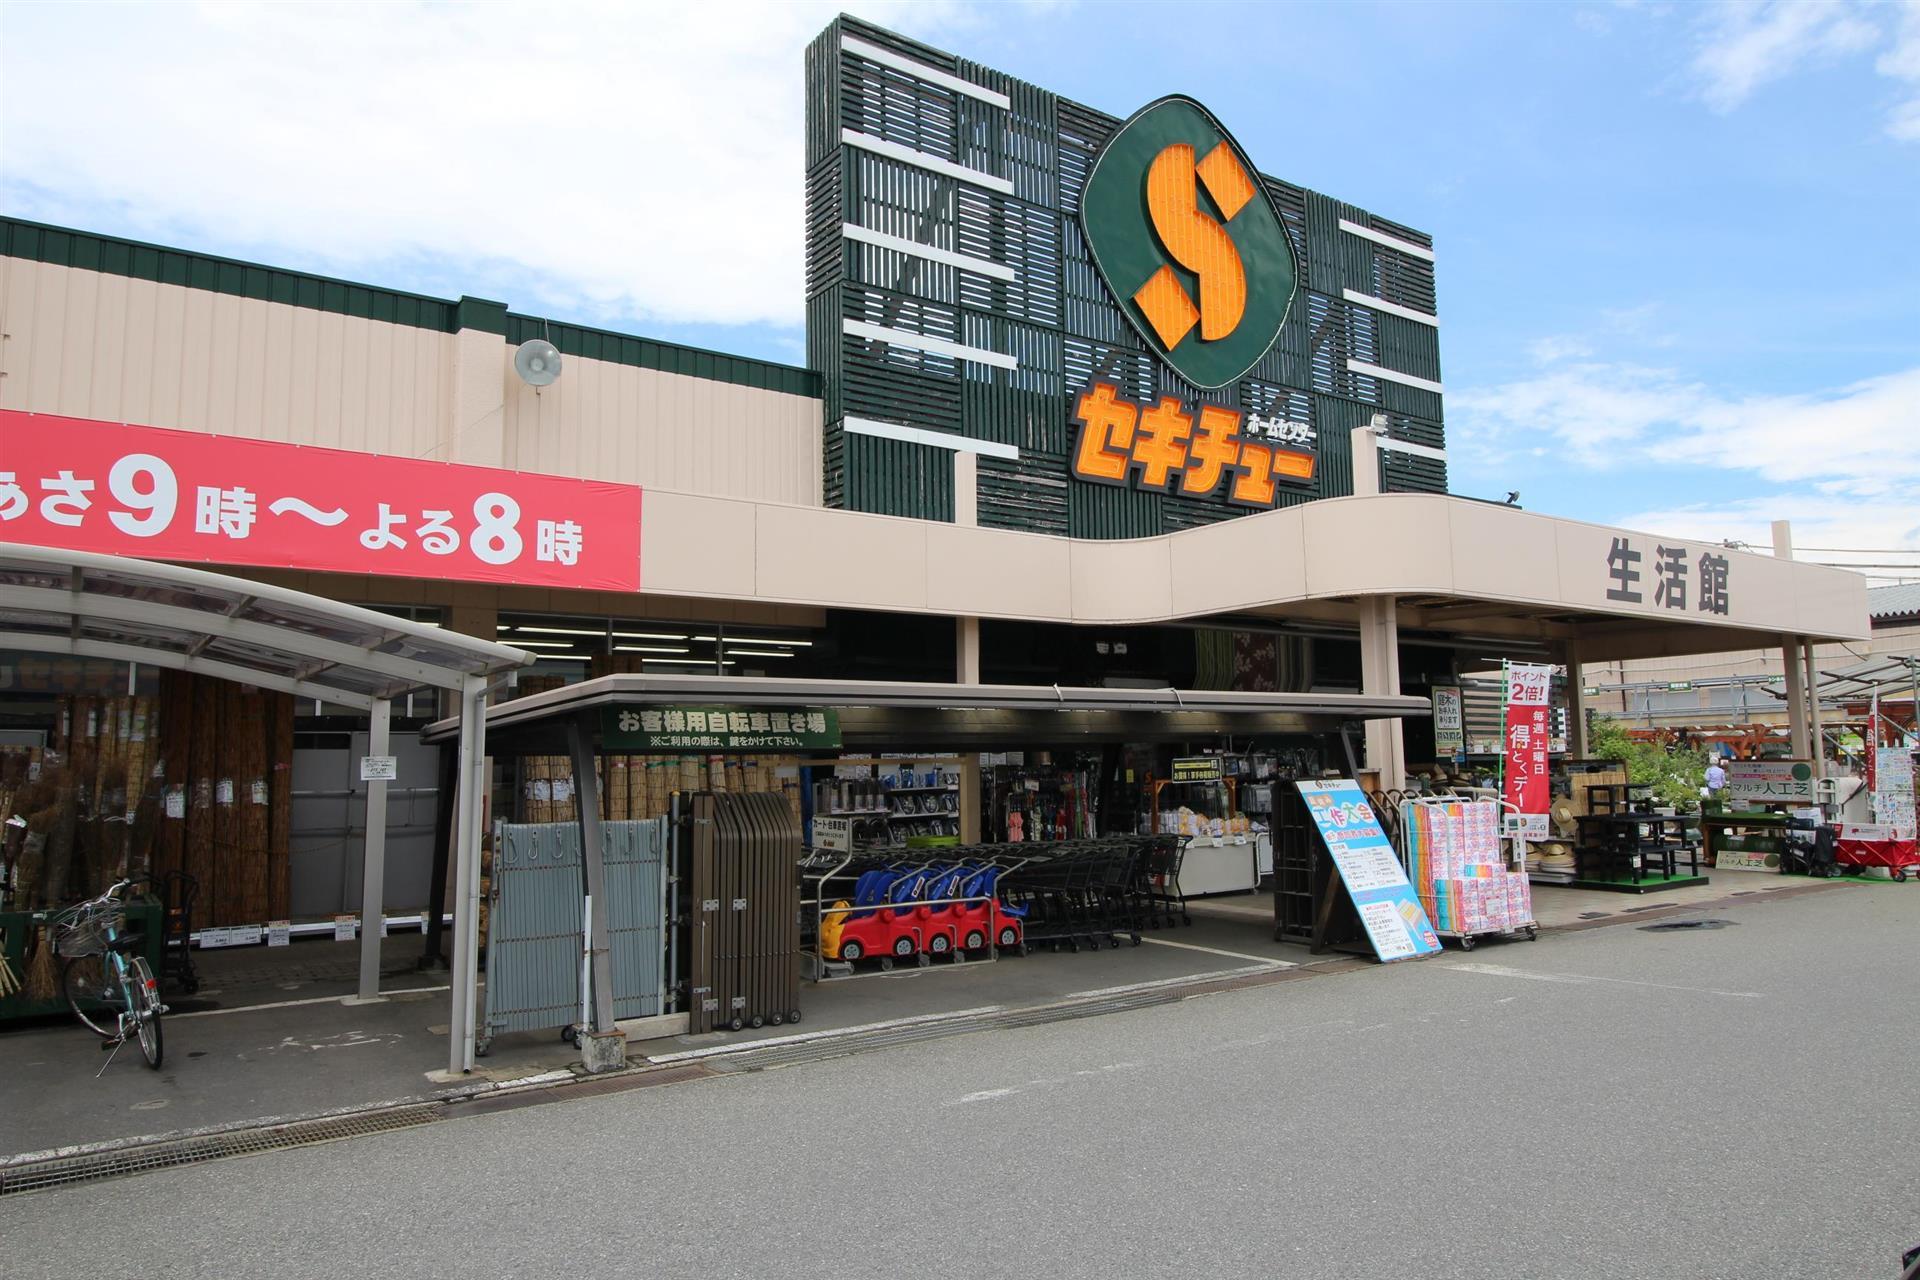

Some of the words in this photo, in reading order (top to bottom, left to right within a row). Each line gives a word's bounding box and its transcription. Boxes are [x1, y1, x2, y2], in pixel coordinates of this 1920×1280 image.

[1246, 413, 1317, 444] ホームセンター
[1077, 383, 1314, 504] セキチュー
[1607, 537, 1728, 615] 生活館
[1511, 671, 1546, 681] ポイント
[1512, 683, 1544, 701] 2倍!
[618, 710, 826, 733] お客様用自転車置き場
[1733, 782, 1809, 796] マルチ人工芝
[1313, 803, 1374, 826] 工作大会
